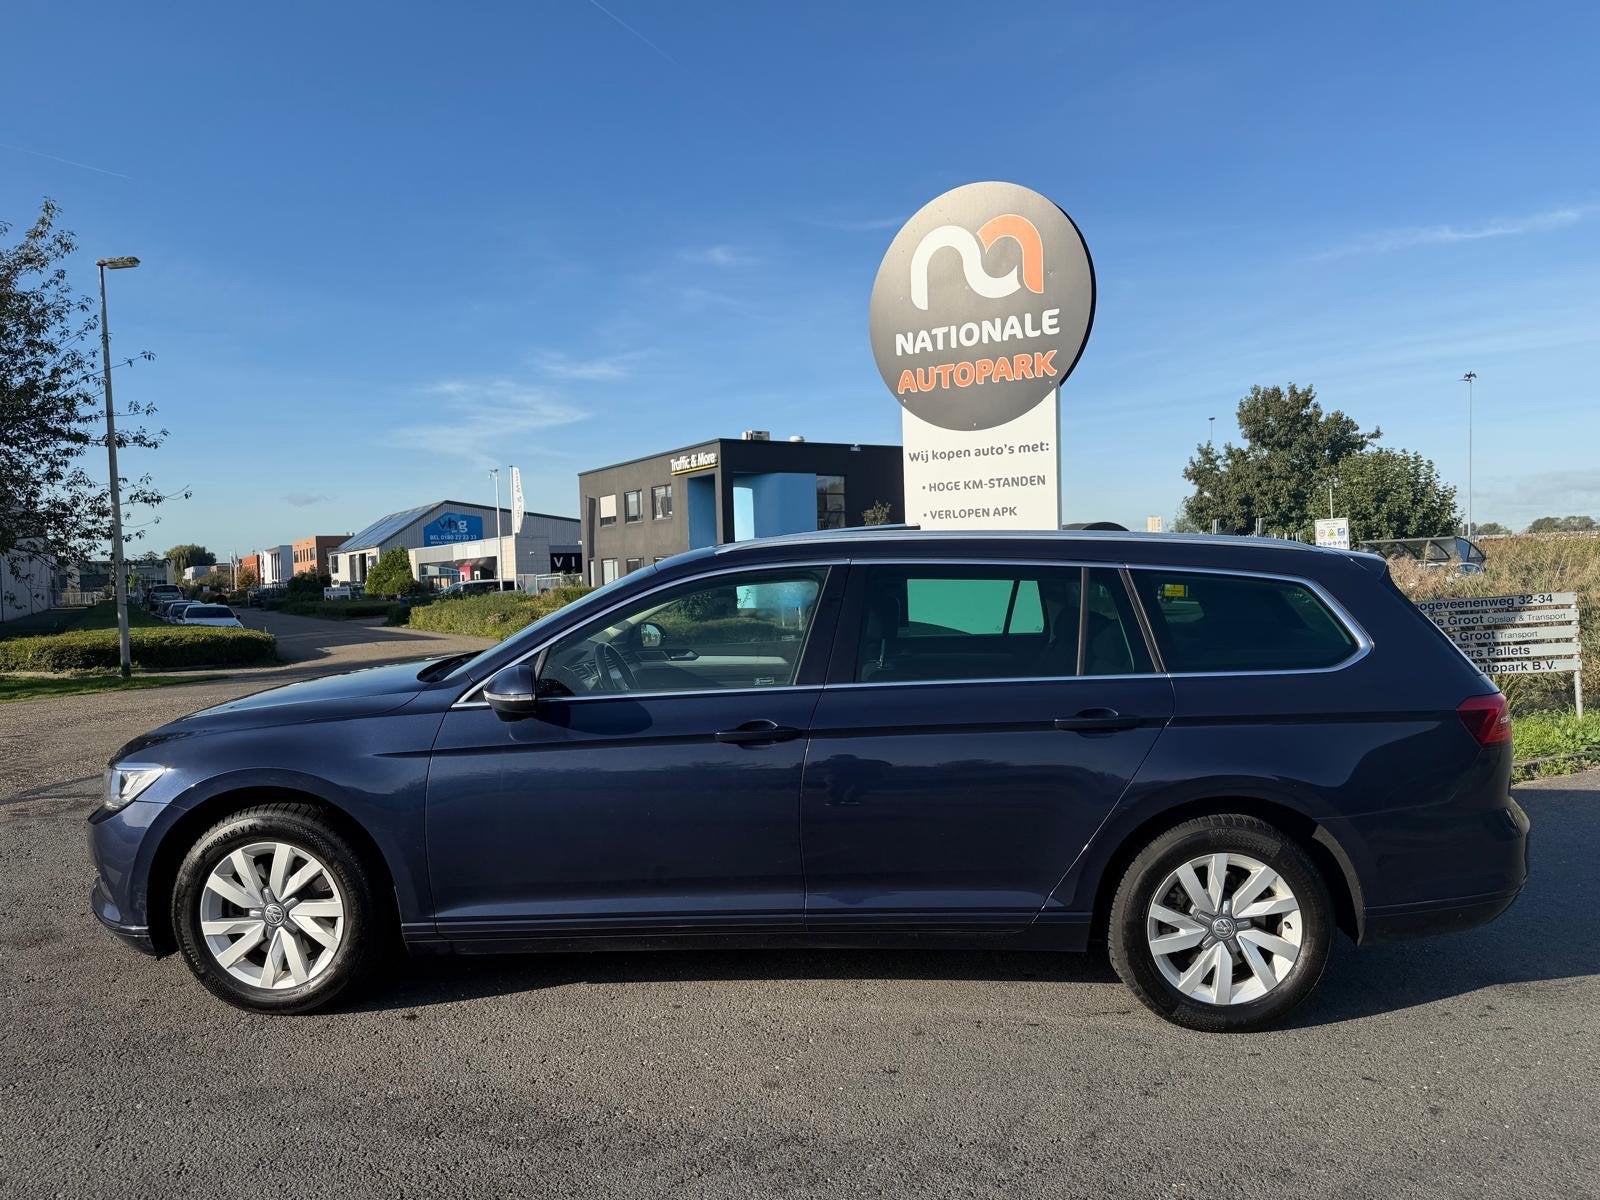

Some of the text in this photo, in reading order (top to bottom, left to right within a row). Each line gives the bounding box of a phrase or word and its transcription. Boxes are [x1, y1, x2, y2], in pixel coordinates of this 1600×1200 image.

[895, 308, 1060, 356] NATIONALE
[897, 349, 1058, 395] AUTOPARK
[909, 441, 1050, 463] Wij kopen auto's met:
[670, 456, 691, 471] Traffic
[697, 452, 717, 466] More
[928, 474, 1046, 492] HOGE KM-STANDEN
[929, 506, 1018, 520] VERLOPEN APK
[1415, 594, 1553, 612] ogeveenenweg 32-34
[1448, 615, 1484, 625] Groot
[1527, 613, 1566, 621] Transport
[1460, 630, 1496, 641] Groot
[1500, 631, 1538, 639] Transport
[1487, 646, 1531, 656] Pallets
[1479, 660, 1557, 674] utopark B.V.
